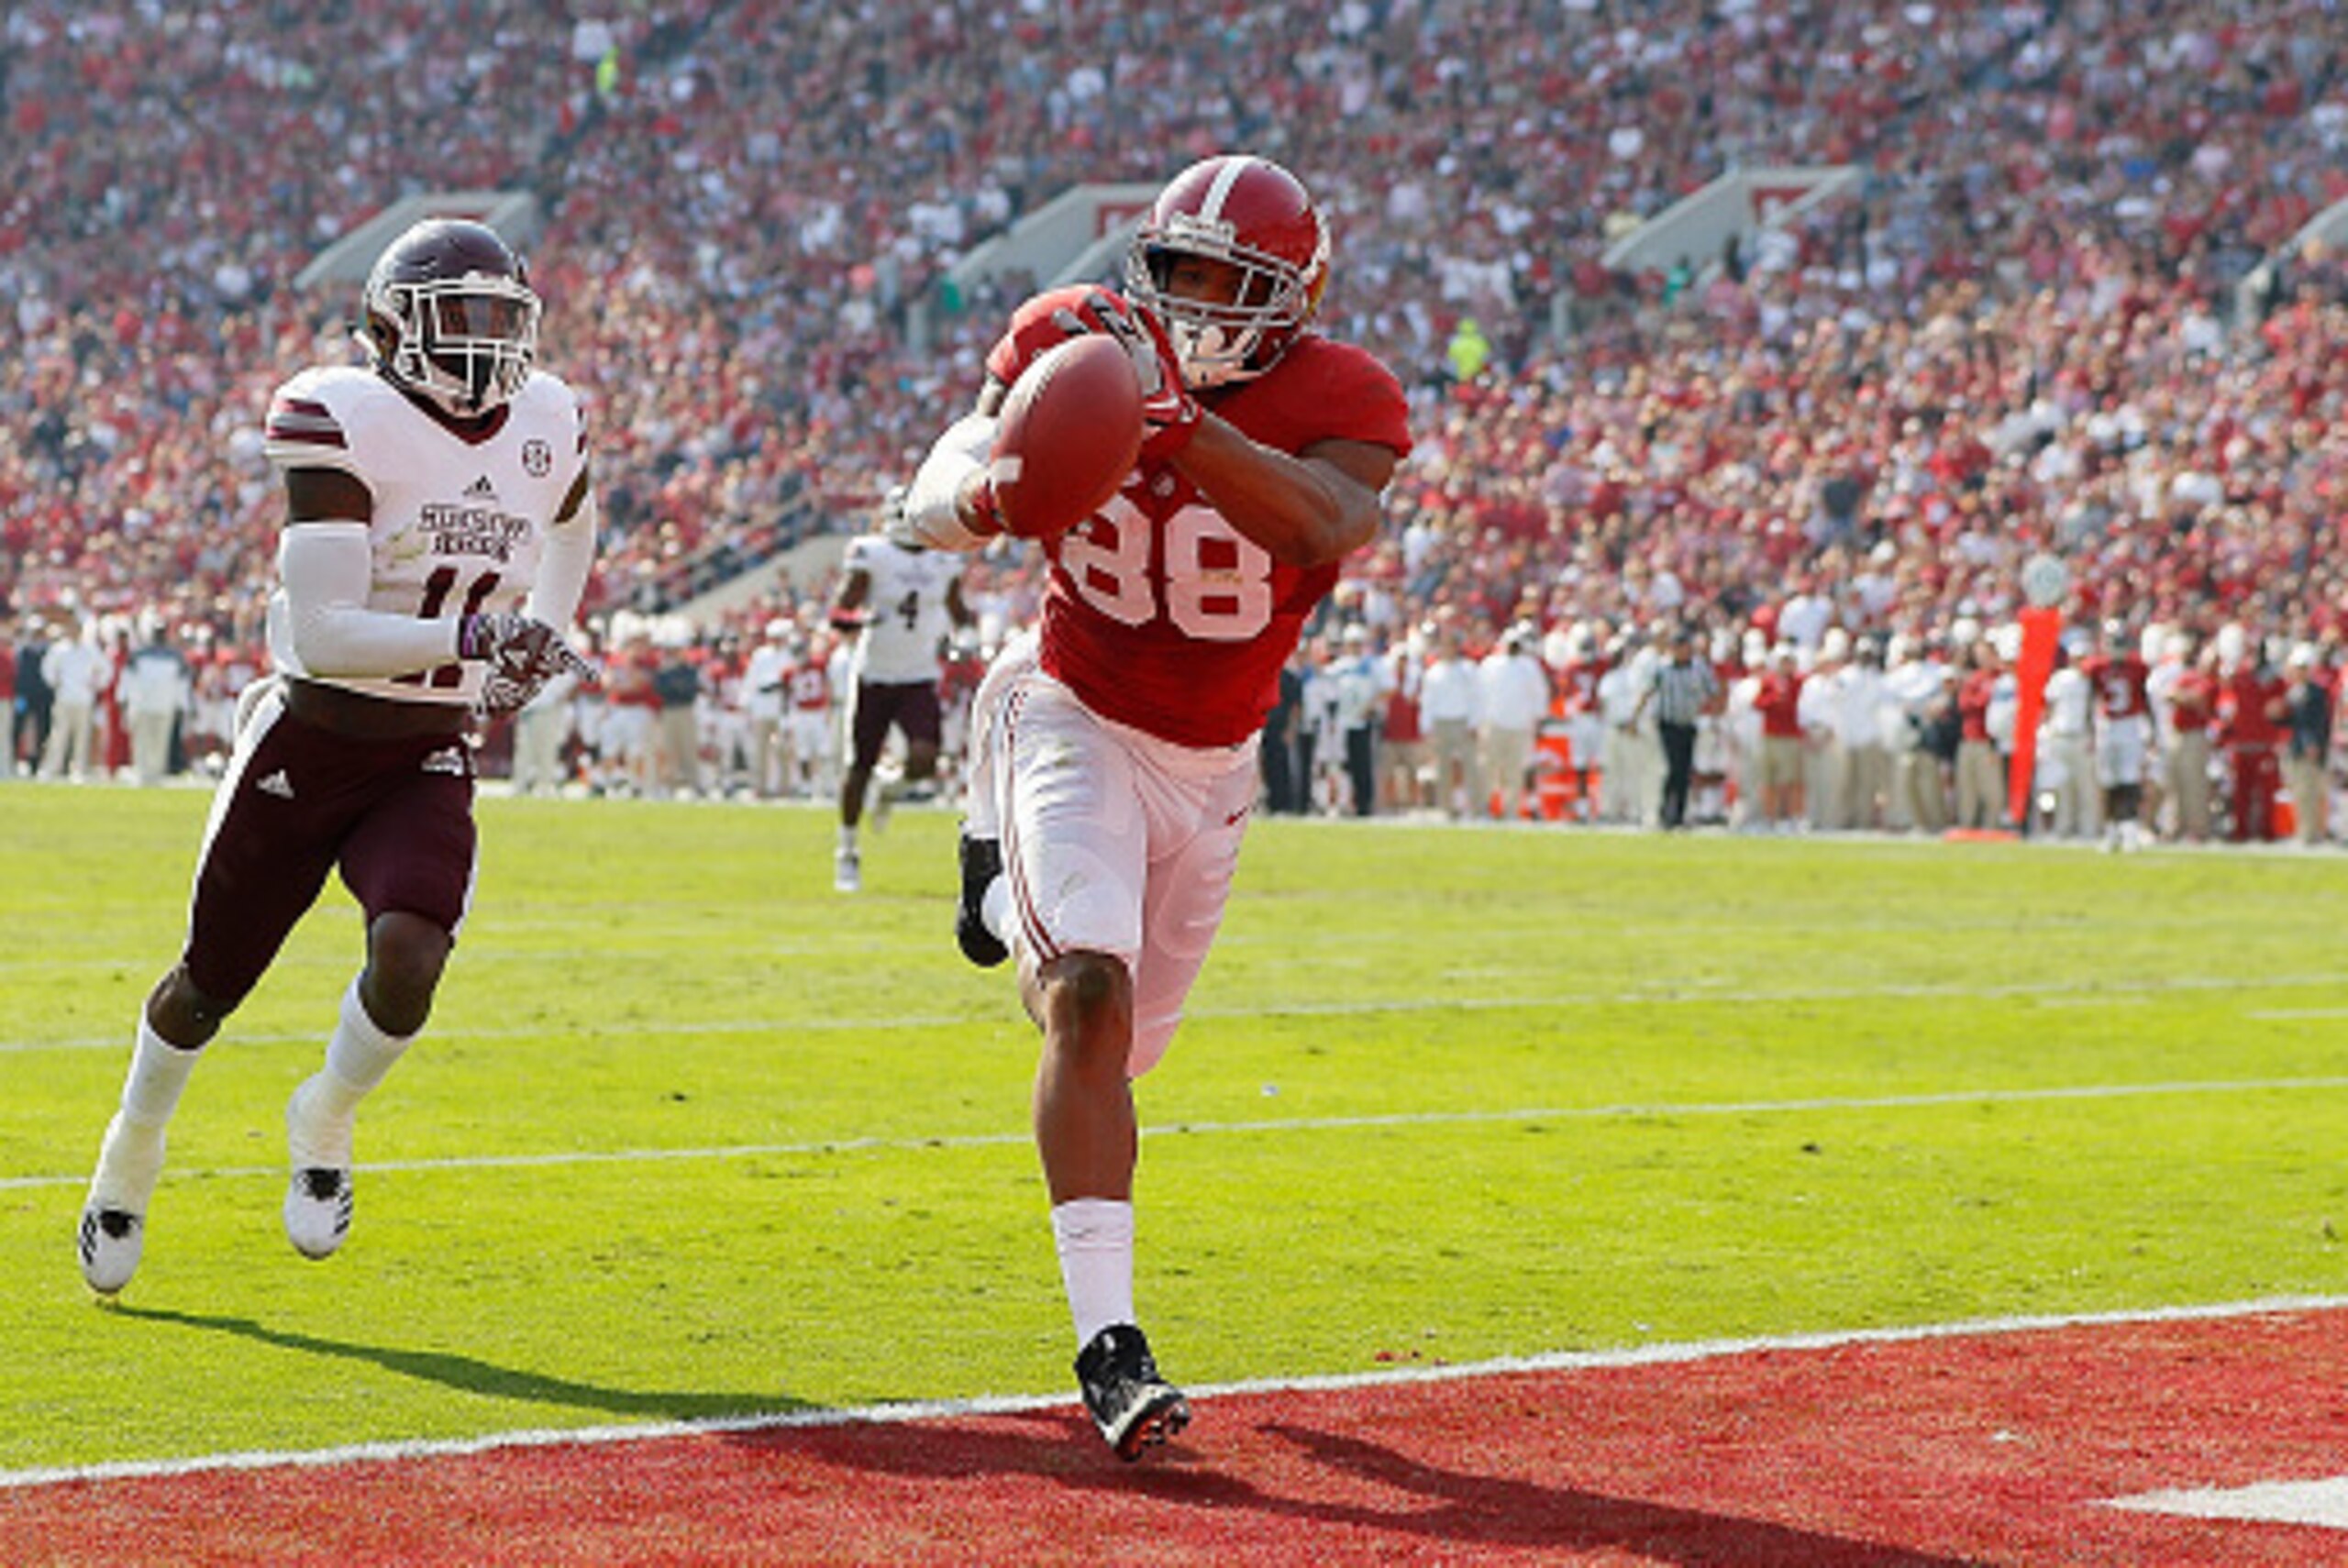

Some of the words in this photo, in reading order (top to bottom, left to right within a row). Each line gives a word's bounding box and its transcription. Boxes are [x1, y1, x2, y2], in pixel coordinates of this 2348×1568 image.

[390, 565, 501, 688] 11
[897, 590, 919, 630] 4
[1059, 492, 1272, 640] 88
